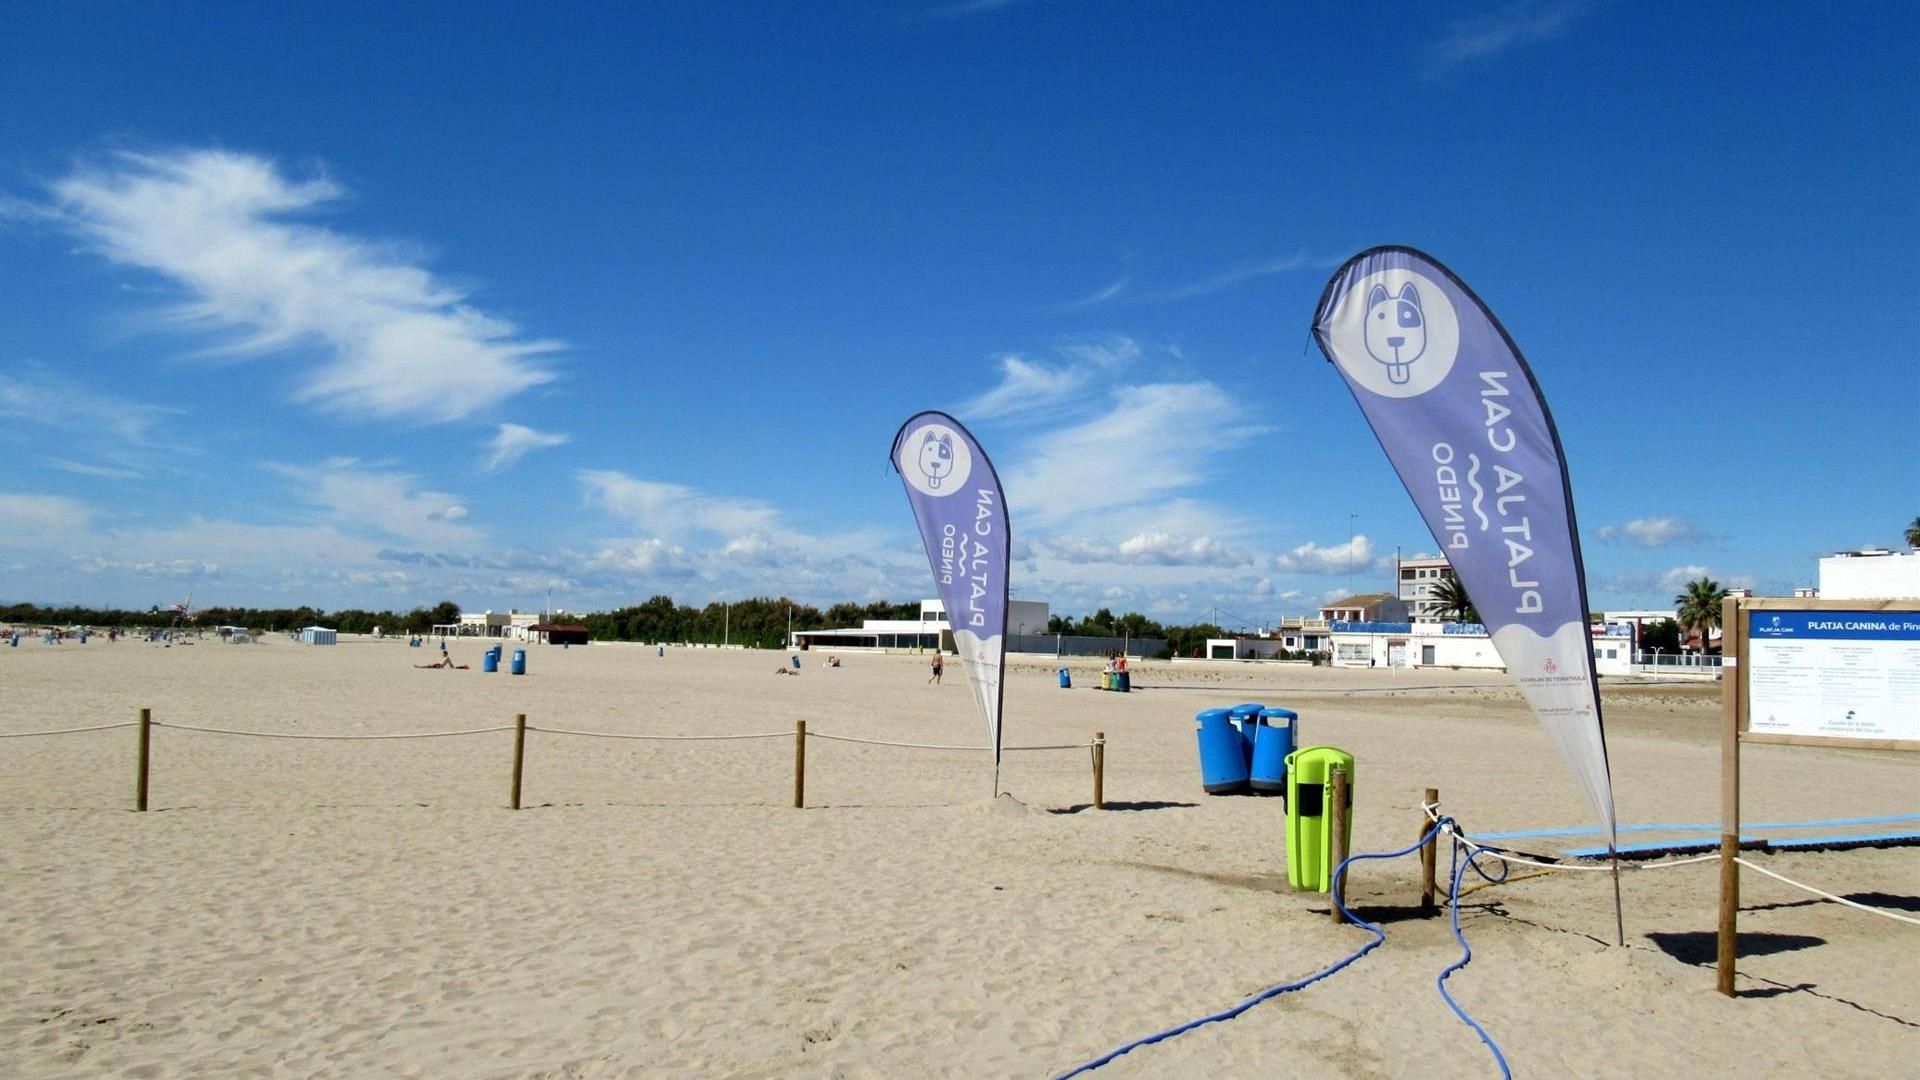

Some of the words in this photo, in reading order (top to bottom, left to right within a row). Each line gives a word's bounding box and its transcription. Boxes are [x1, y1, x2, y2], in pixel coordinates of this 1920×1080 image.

[1808, 621, 1844, 630] PLATJA
[1845, 621, 1887, 631] CANINA
[1888, 622, 1901, 631] de
[1903, 622, 1920, 631] Pin
